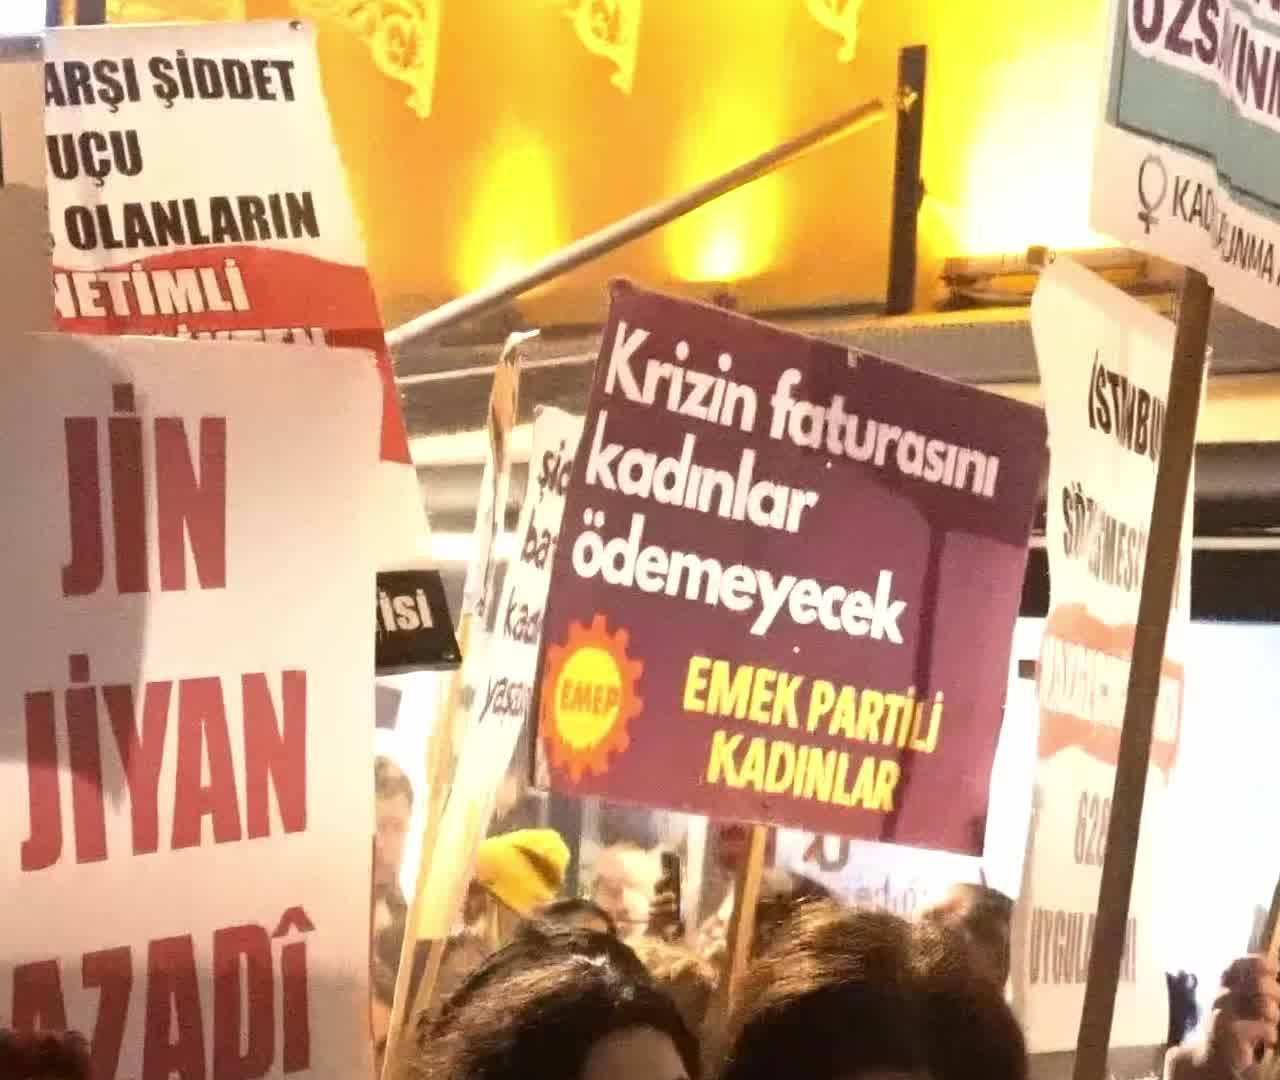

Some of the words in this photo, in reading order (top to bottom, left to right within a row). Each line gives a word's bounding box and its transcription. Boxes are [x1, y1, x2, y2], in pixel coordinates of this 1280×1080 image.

[45, 58, 141, 113] ARŞI
[147, 49, 296, 109] ŞİDDET
[46, 129, 143, 187] UÇU
[64, 191, 321, 251] OLANLARIN
[604, 321, 757, 432] Krizin
[768, 367, 1001, 498] faturasını
[61, 382, 227, 597] JİN
[585, 410, 819, 534] kadınlar
[572, 508, 907, 645] ödemeyecek
[560, 679, 622, 716] EMEP
[683, 655, 804, 730] EMEK
[807, 680, 943, 754] PARTİLİ
[20, 653, 307, 873] JİYAN
[707, 730, 901, 812] KADINLAR
